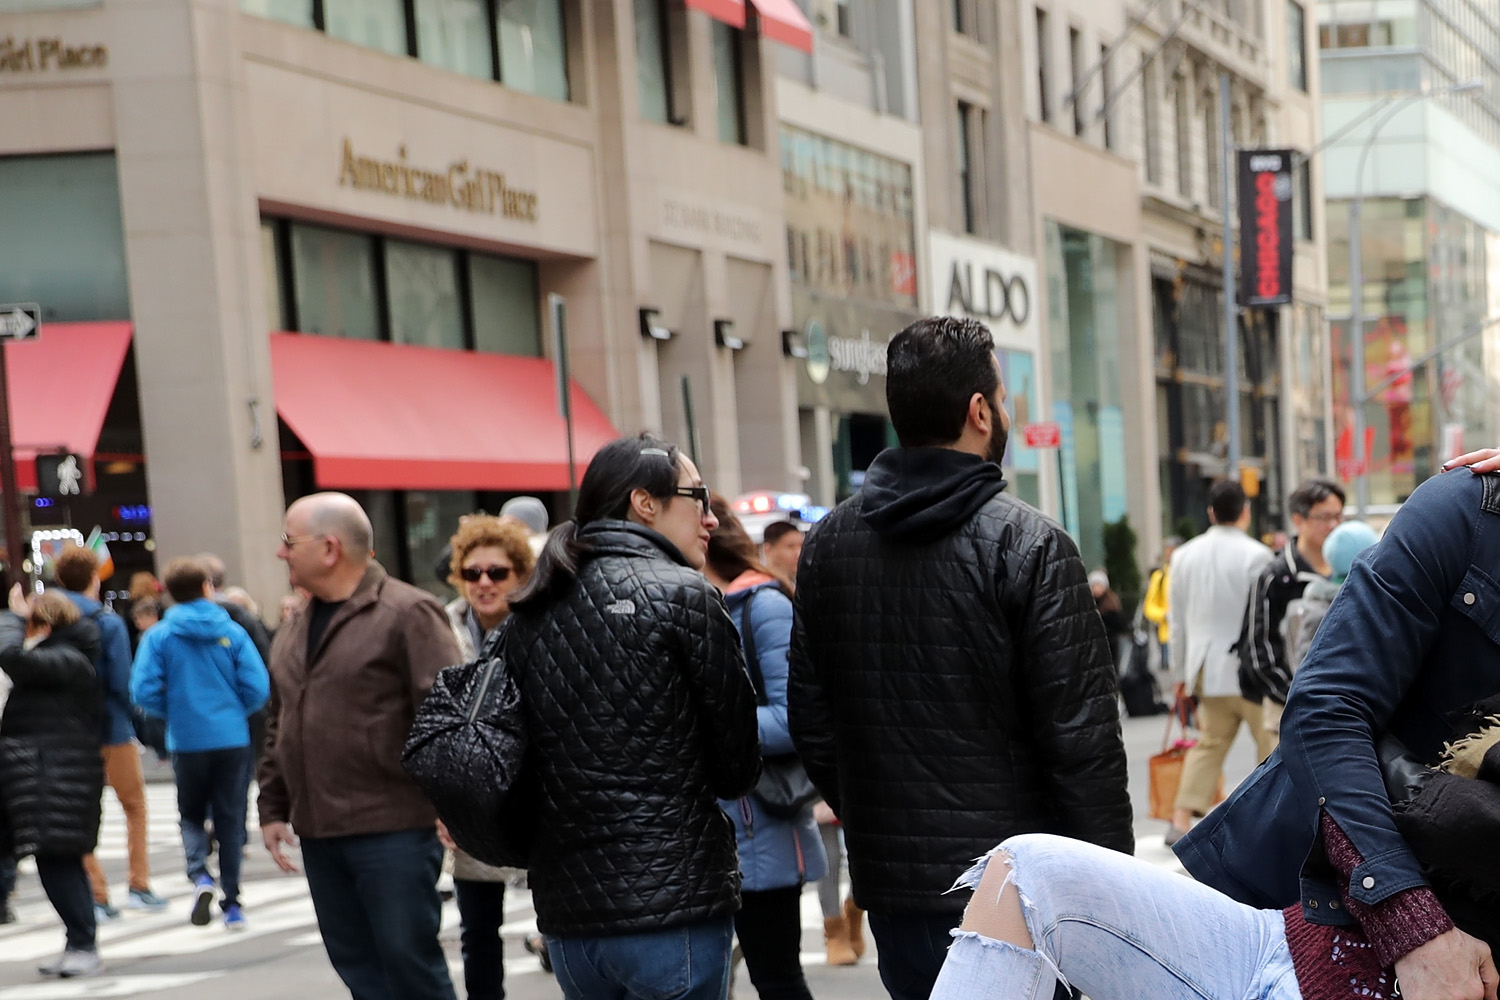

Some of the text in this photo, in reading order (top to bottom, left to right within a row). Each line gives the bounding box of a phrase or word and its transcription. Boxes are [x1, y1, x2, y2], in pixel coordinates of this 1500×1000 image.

[340, 137, 449, 205] American
[487, 169, 538, 224] Place
[946, 259, 1028, 325] ALDO
